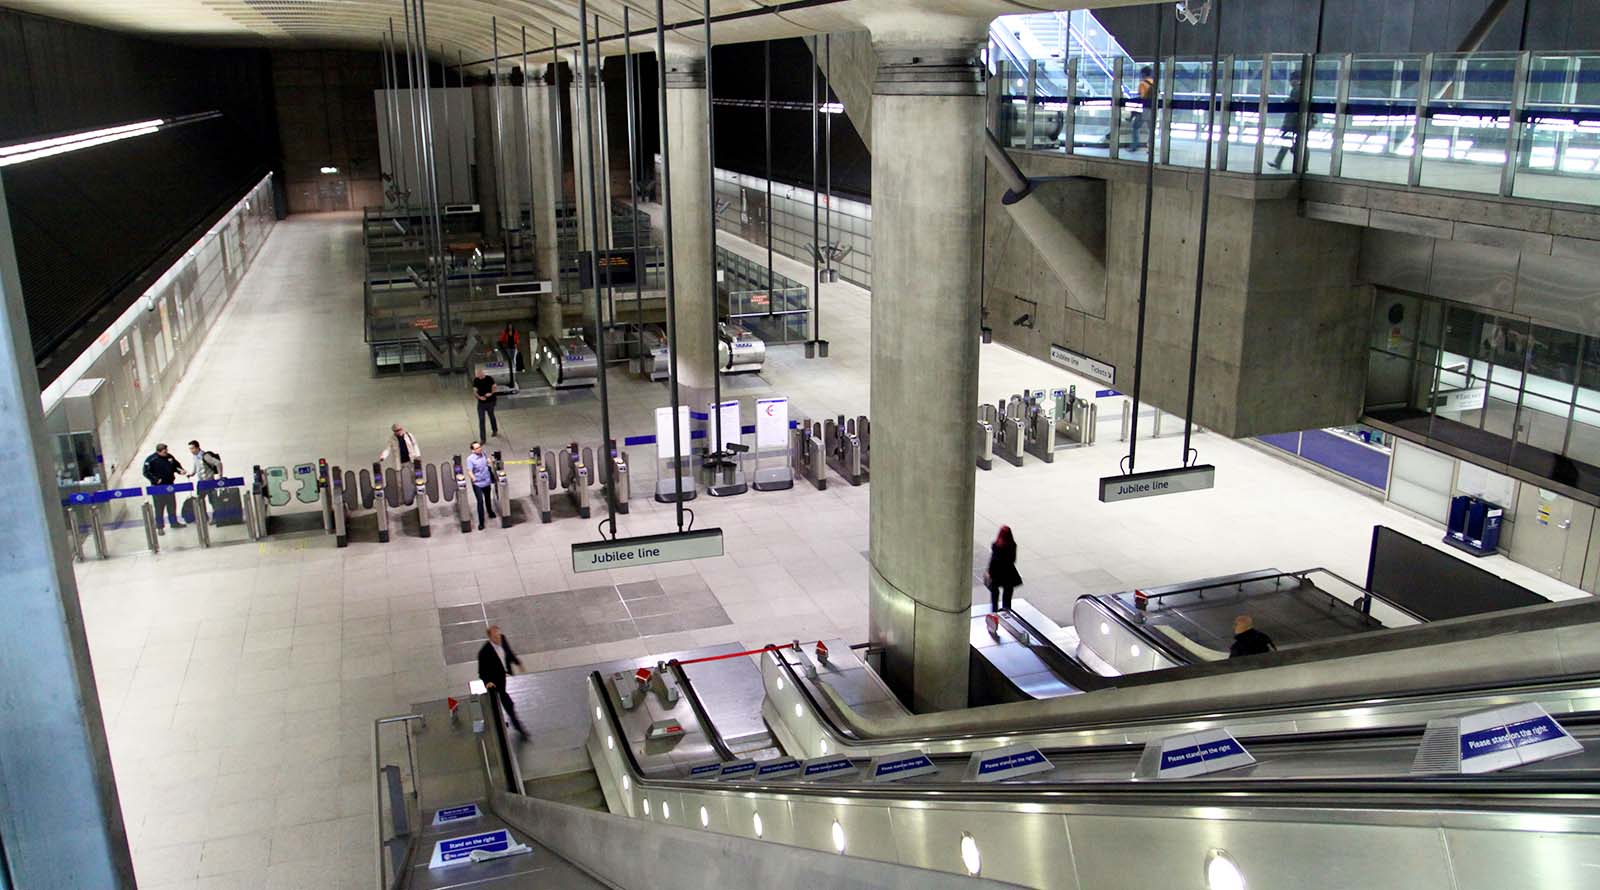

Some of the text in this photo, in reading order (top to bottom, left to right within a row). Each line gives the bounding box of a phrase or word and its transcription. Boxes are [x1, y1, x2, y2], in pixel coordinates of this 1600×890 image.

[1118, 481, 1169, 495] Jubilee line
[591, 548, 660, 564] Jubilee line
[1468, 739, 1491, 749] Please
[1491, 733, 1510, 743] stand
[1520, 728, 1533, 738] the
[1532, 725, 1549, 736] right
